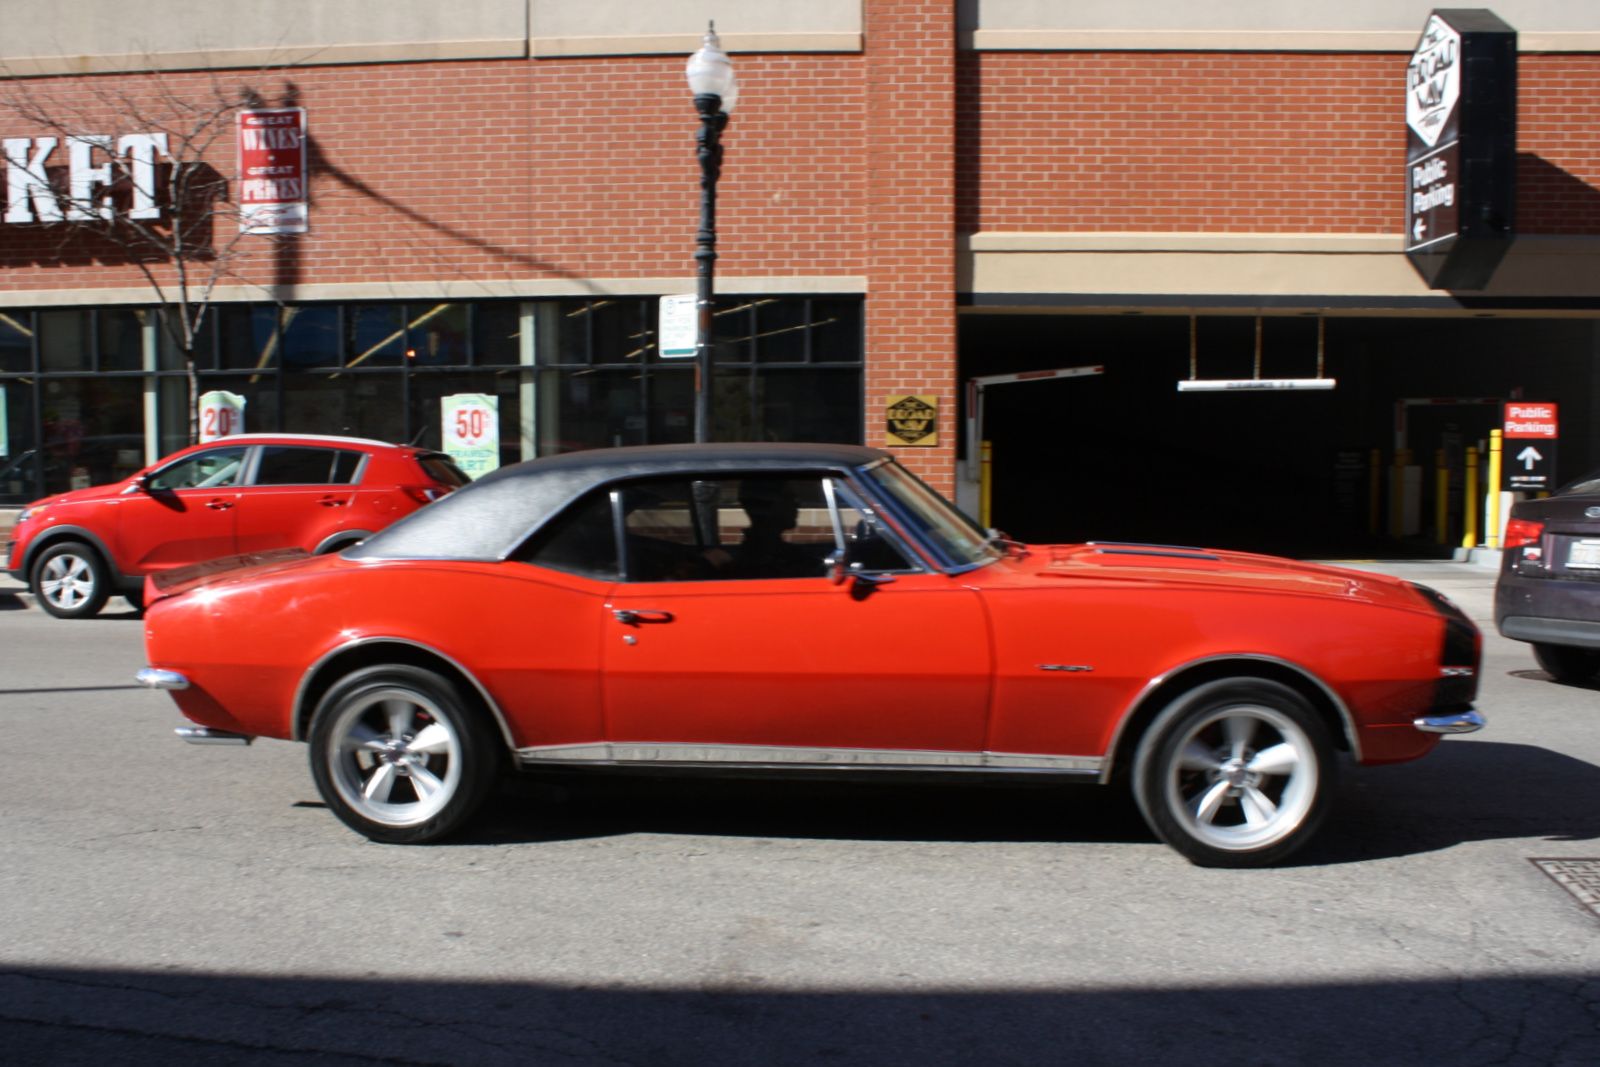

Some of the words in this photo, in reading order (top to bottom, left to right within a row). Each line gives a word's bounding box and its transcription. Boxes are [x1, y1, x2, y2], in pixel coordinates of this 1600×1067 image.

[2, 133, 168, 223] KET
[1413, 157, 1448, 189] Public
[1413, 183, 1455, 214] Parking
[1509, 407, 1552, 418] Public
[1504, 421, 1556, 436] Parking
